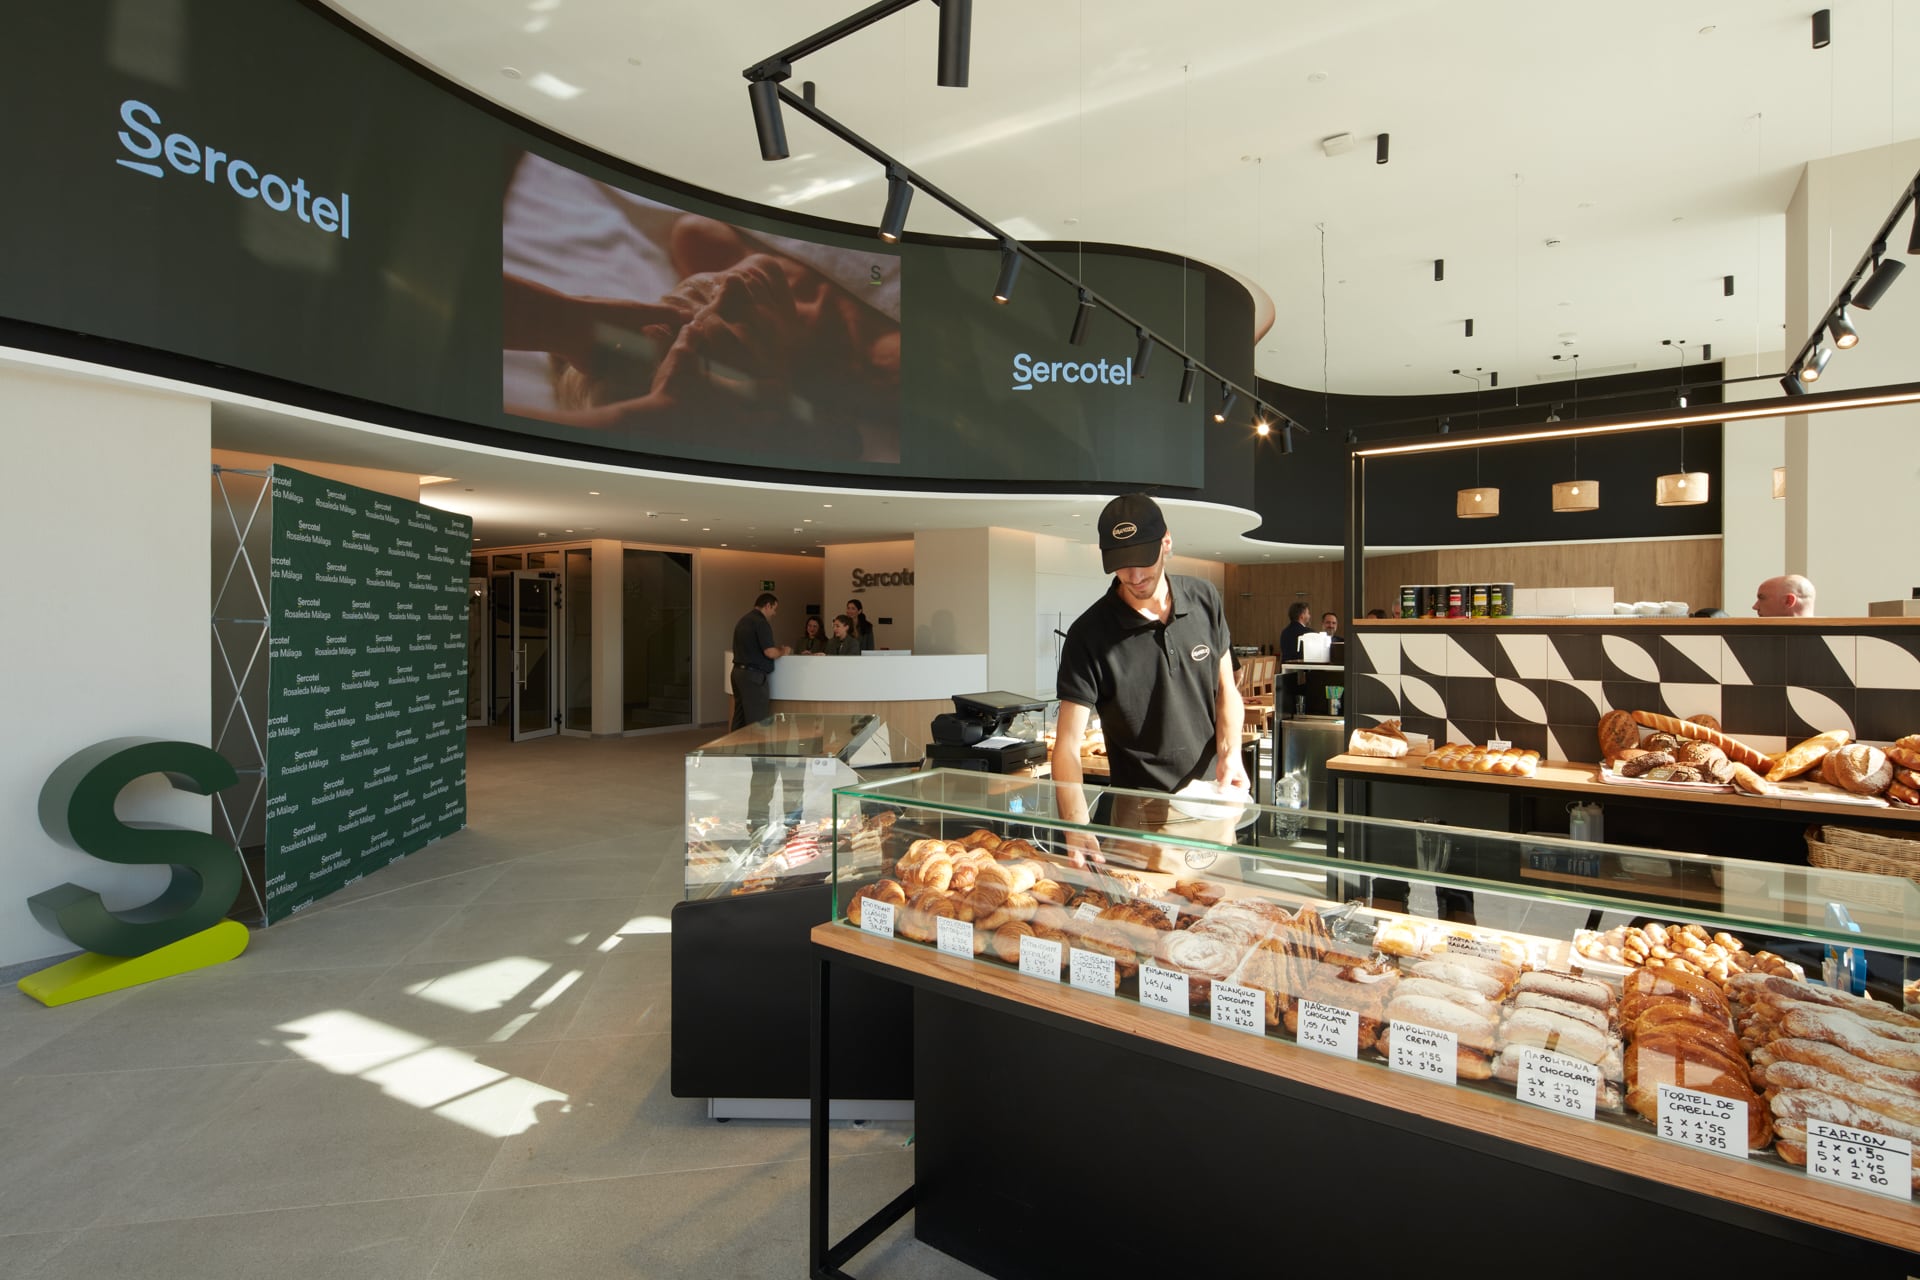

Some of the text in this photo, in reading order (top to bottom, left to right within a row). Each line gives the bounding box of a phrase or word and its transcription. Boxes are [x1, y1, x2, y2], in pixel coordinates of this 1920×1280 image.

[116, 99, 349, 239] Sercotel
[1012, 353, 1132, 387] Sercotel
[1217, 994, 1254, 1007] CHOCOLATE
[1305, 1010, 1347, 1026] CHOCOLATE
[1317, 1034, 1338, 1048] 3,50
[1405, 1034, 1439, 1048] CREMA
[1419, 1051, 1442, 1063] 1'55
[1524, 1050, 1590, 1073] NAPOLITANA
[1419, 1061, 1444, 1074] 3'50
[1526, 1062, 1596, 1087] 2 CHOCOLATES
[1554, 1094, 1581, 1110] 3'85
[1659, 1087, 1735, 1111] TORTEL DE
[1669, 1104, 1731, 1120] CABELLO
[1663, 1115, 1673, 1124] 1
[1694, 1120, 1726, 1136] 1'55
[1664, 1125, 1674, 1137] 3
[1695, 1133, 1726, 1149] 3'85
[1817, 1126, 1886, 1147] FARTON
[1817, 1140, 1827, 1149] 1
[1817, 1150, 1828, 1161] 5
[1815, 1163, 1827, 1174] 10
